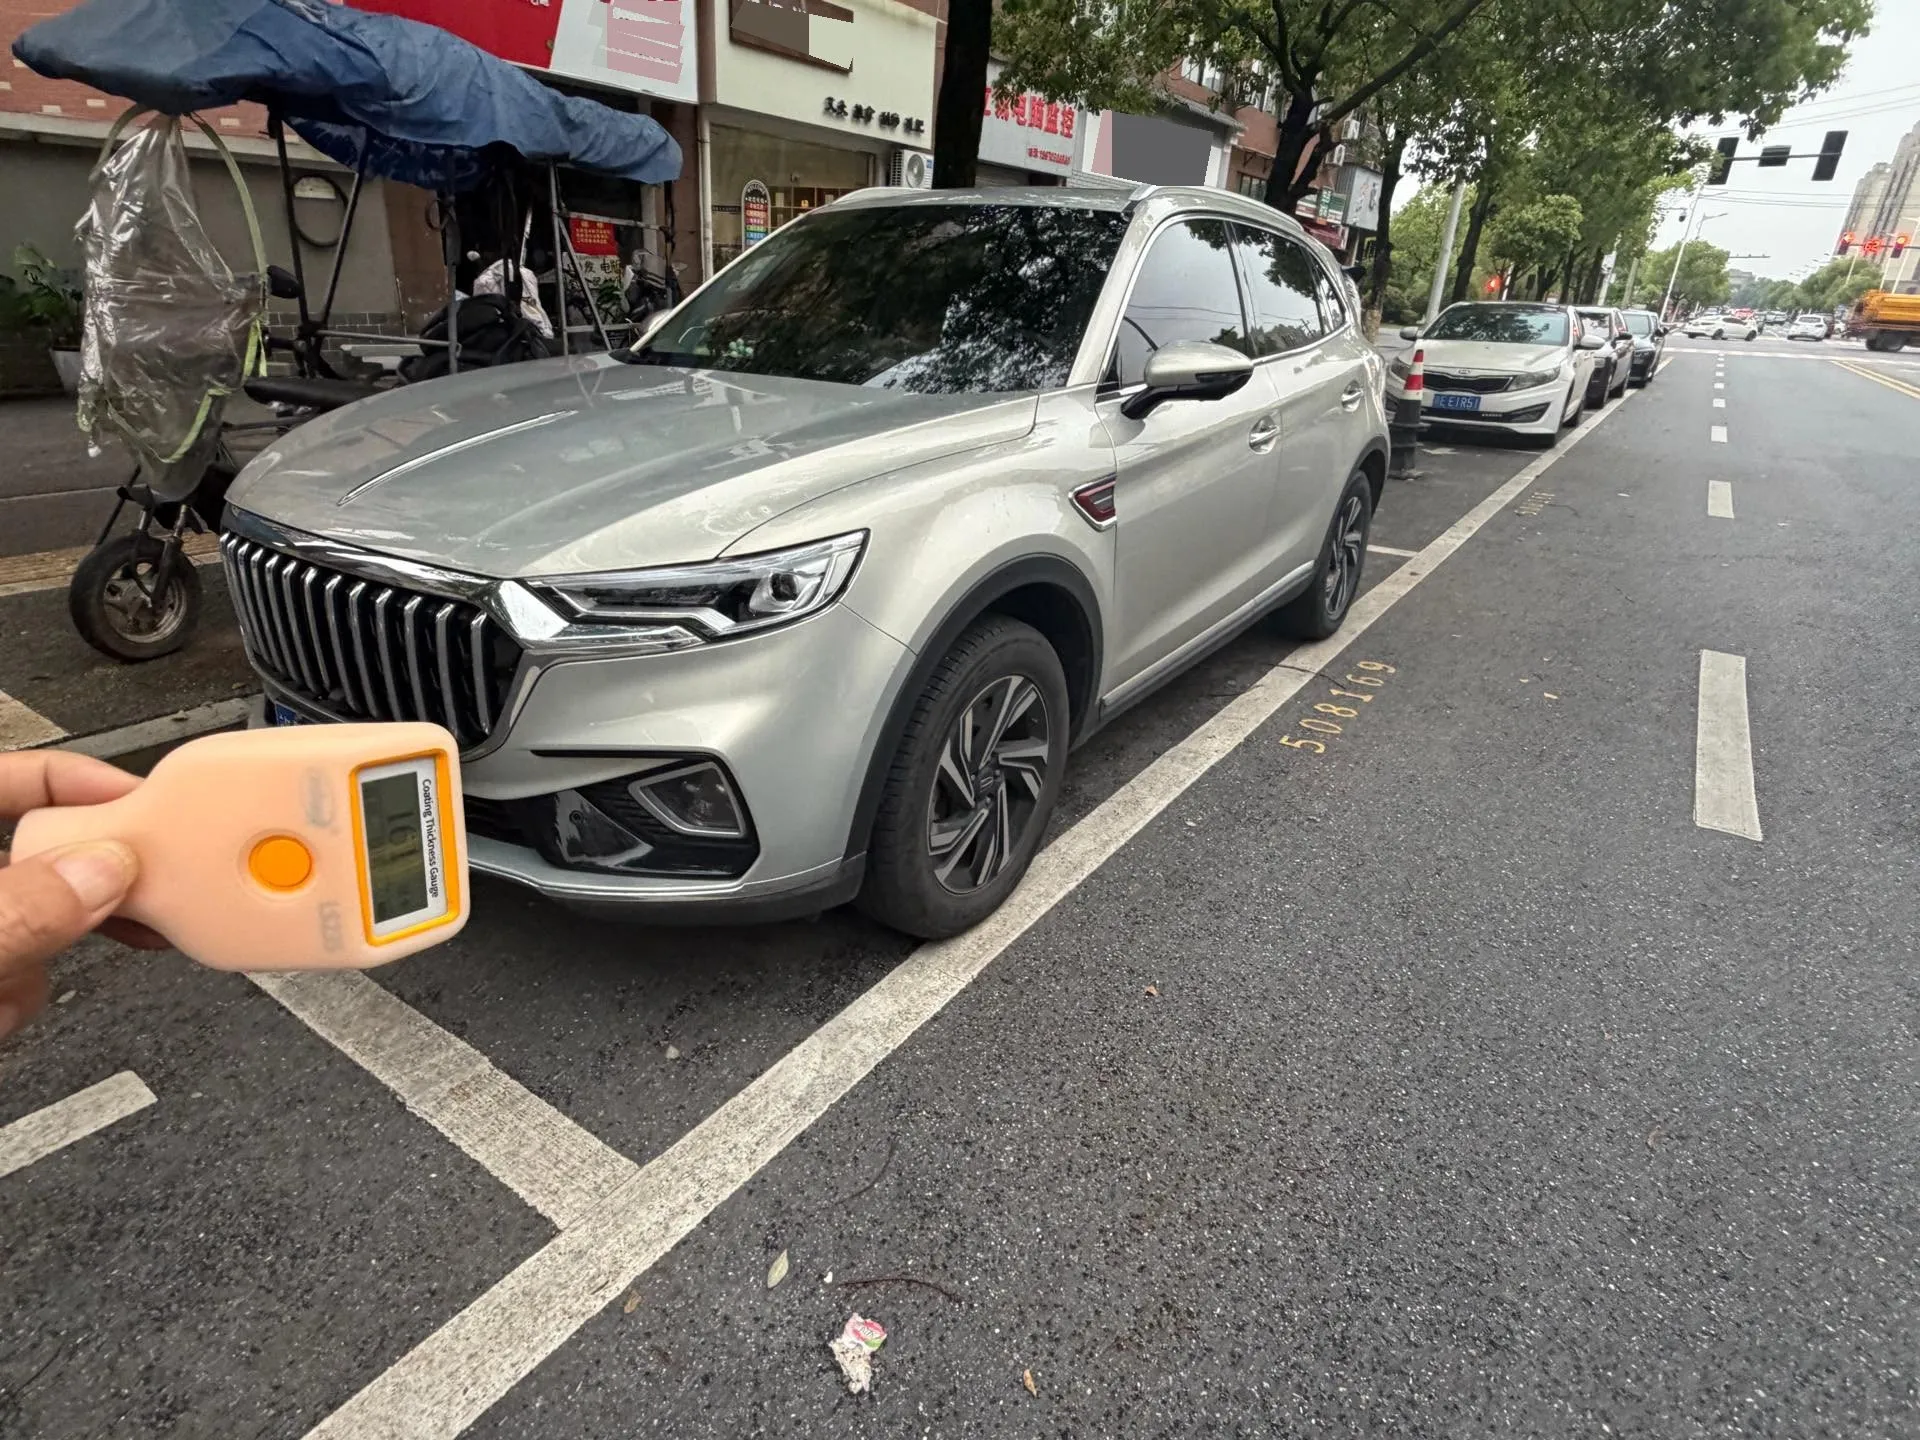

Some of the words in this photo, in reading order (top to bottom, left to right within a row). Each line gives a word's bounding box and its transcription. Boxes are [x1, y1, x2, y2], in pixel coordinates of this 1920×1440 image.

[1279, 660, 1397, 754] 508169
[422, 778, 433, 818] Coating
[426, 818, 438, 867] Thickness
[429, 866, 439, 898] Gauge
